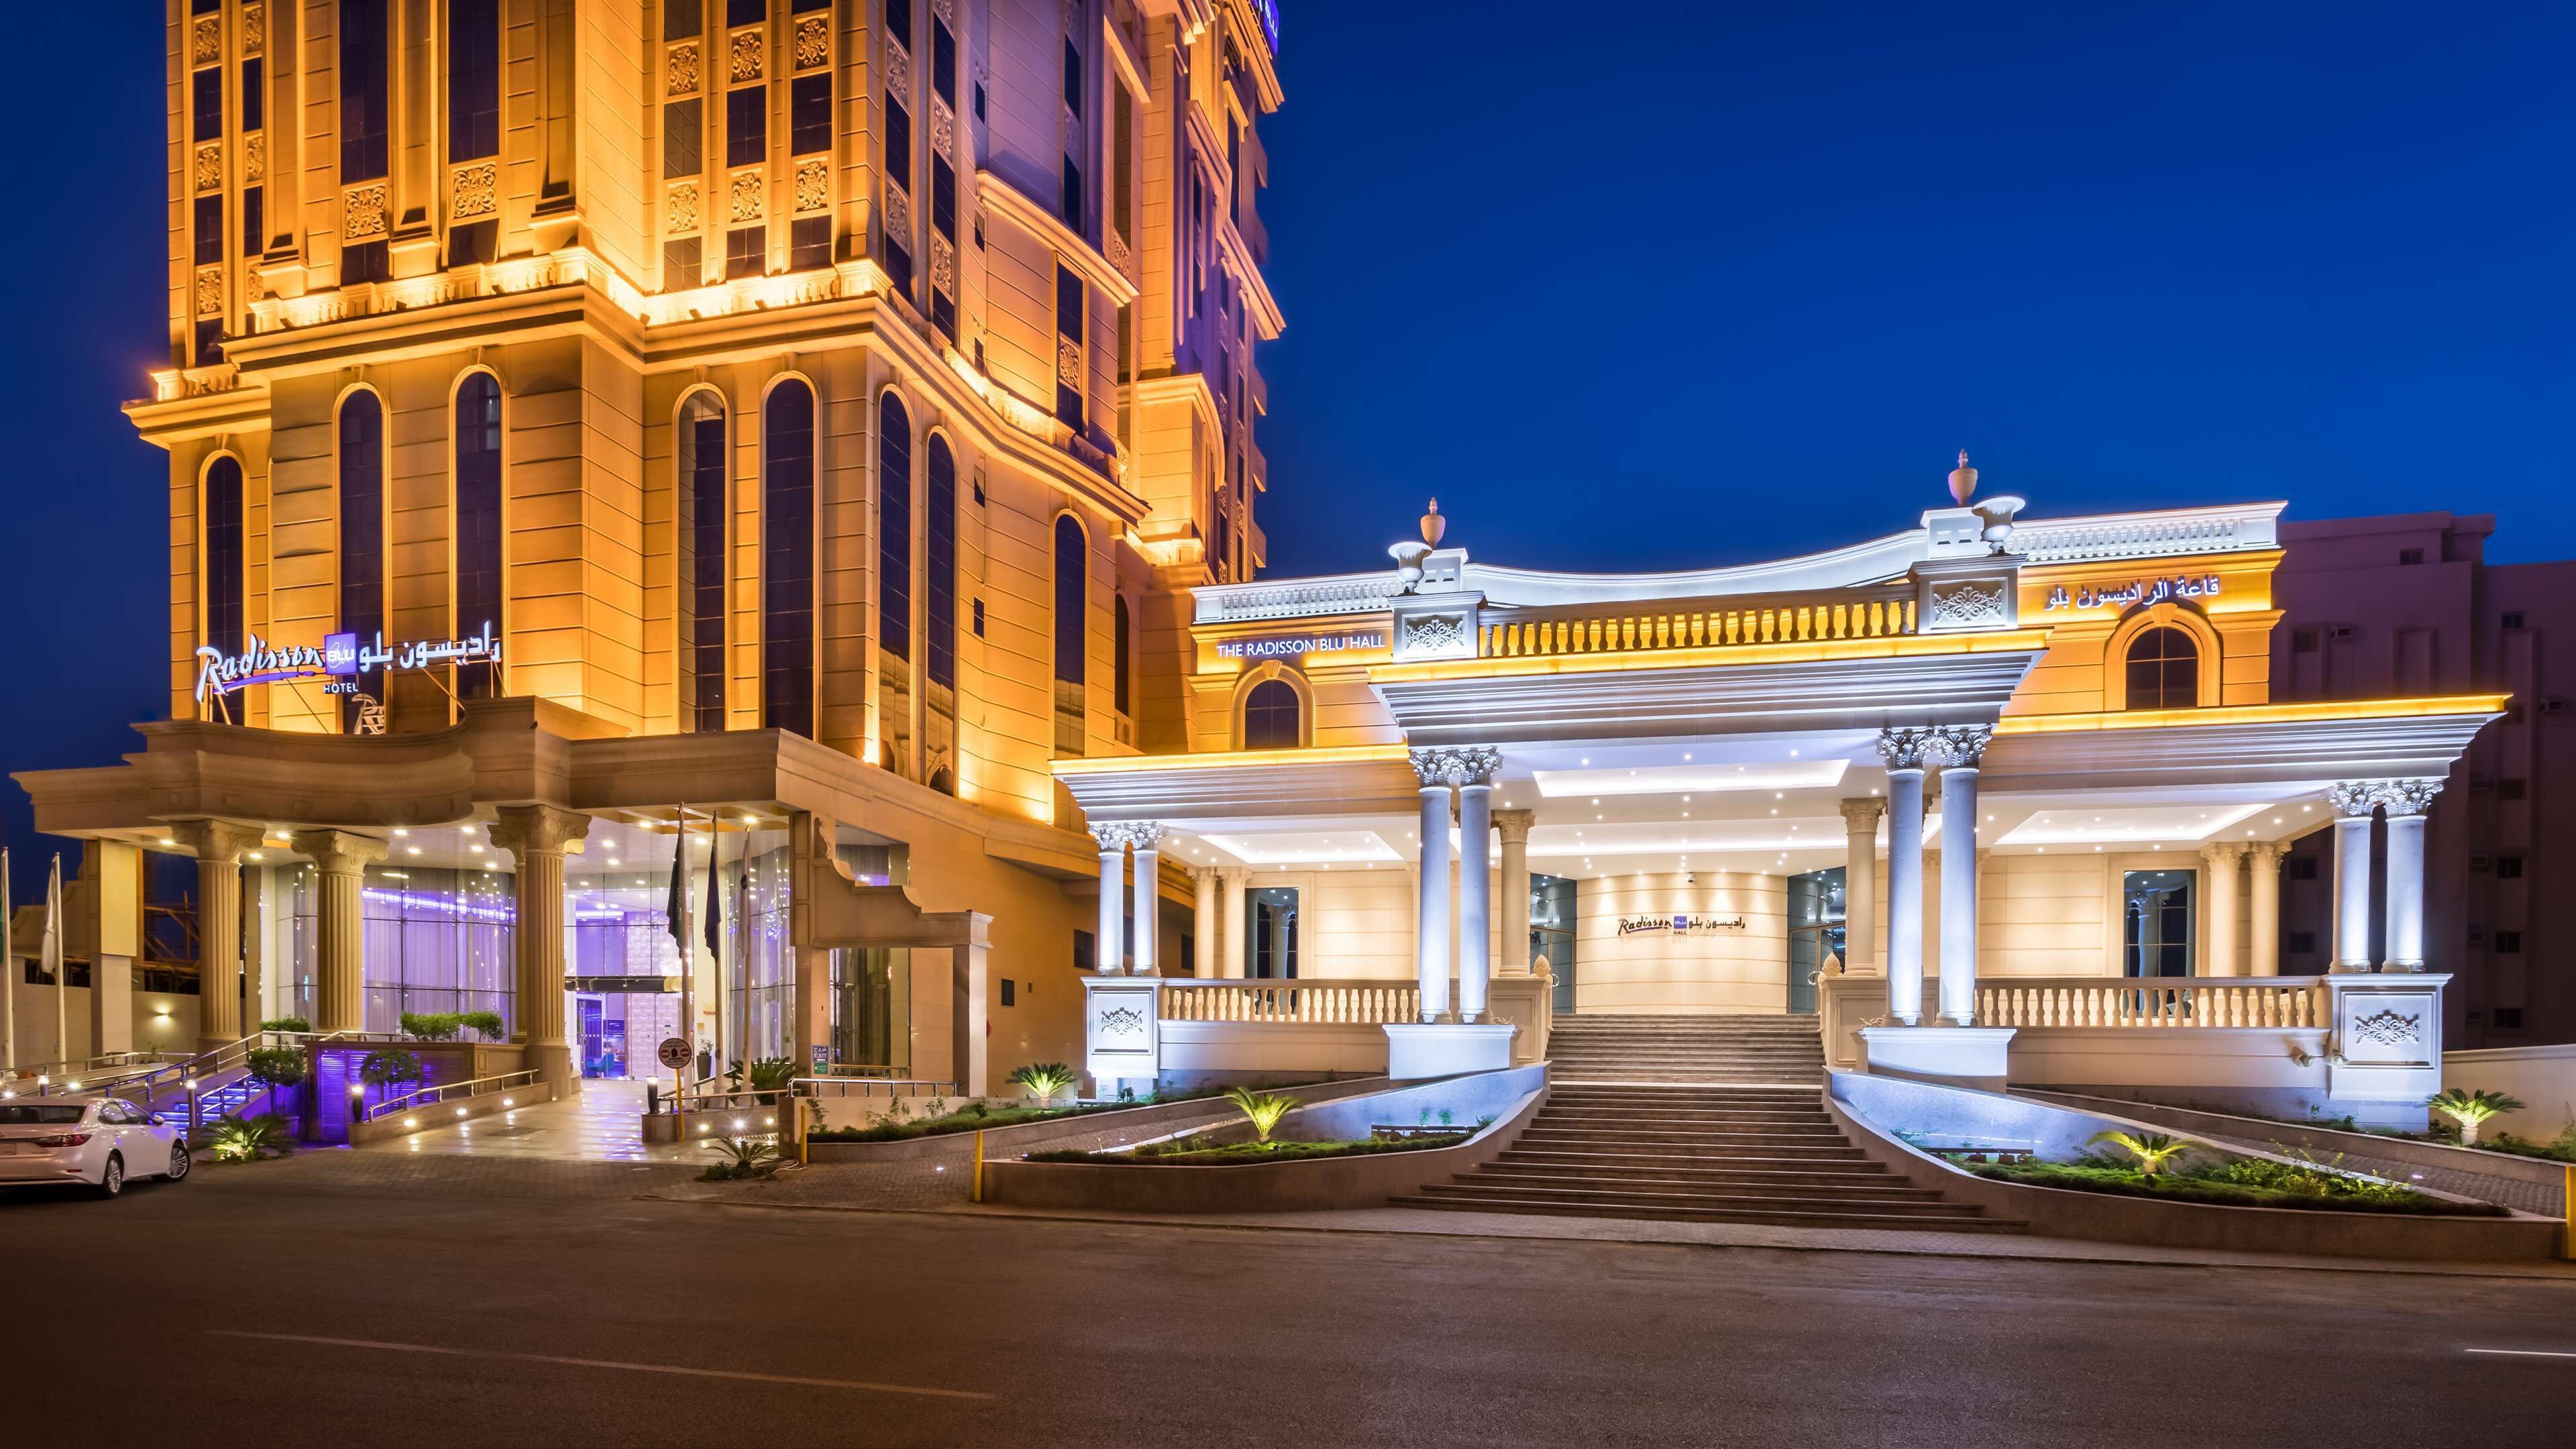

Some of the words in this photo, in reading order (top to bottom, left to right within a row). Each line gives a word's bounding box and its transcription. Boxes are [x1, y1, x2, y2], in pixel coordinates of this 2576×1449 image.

[2176, 578, 2219, 596] قاعة
[2045, 588, 2070, 611] بلو
[359, 631, 393, 672] بلو
[400, 621, 502, 668] راديسون
[1216, 645, 1243, 657] THE
[1247, 640, 1316, 656] RADISSON
[1320, 637, 1346, 651] BLU
[1350, 635, 1385, 649] HALL
[197, 633, 323, 704] Radisson
[323, 682, 358, 694] HOTEL
[1617, 915, 1672, 936] Radisson
[1688, 916, 1703, 929] بلو
[1705, 916, 1746, 929] راديسون
